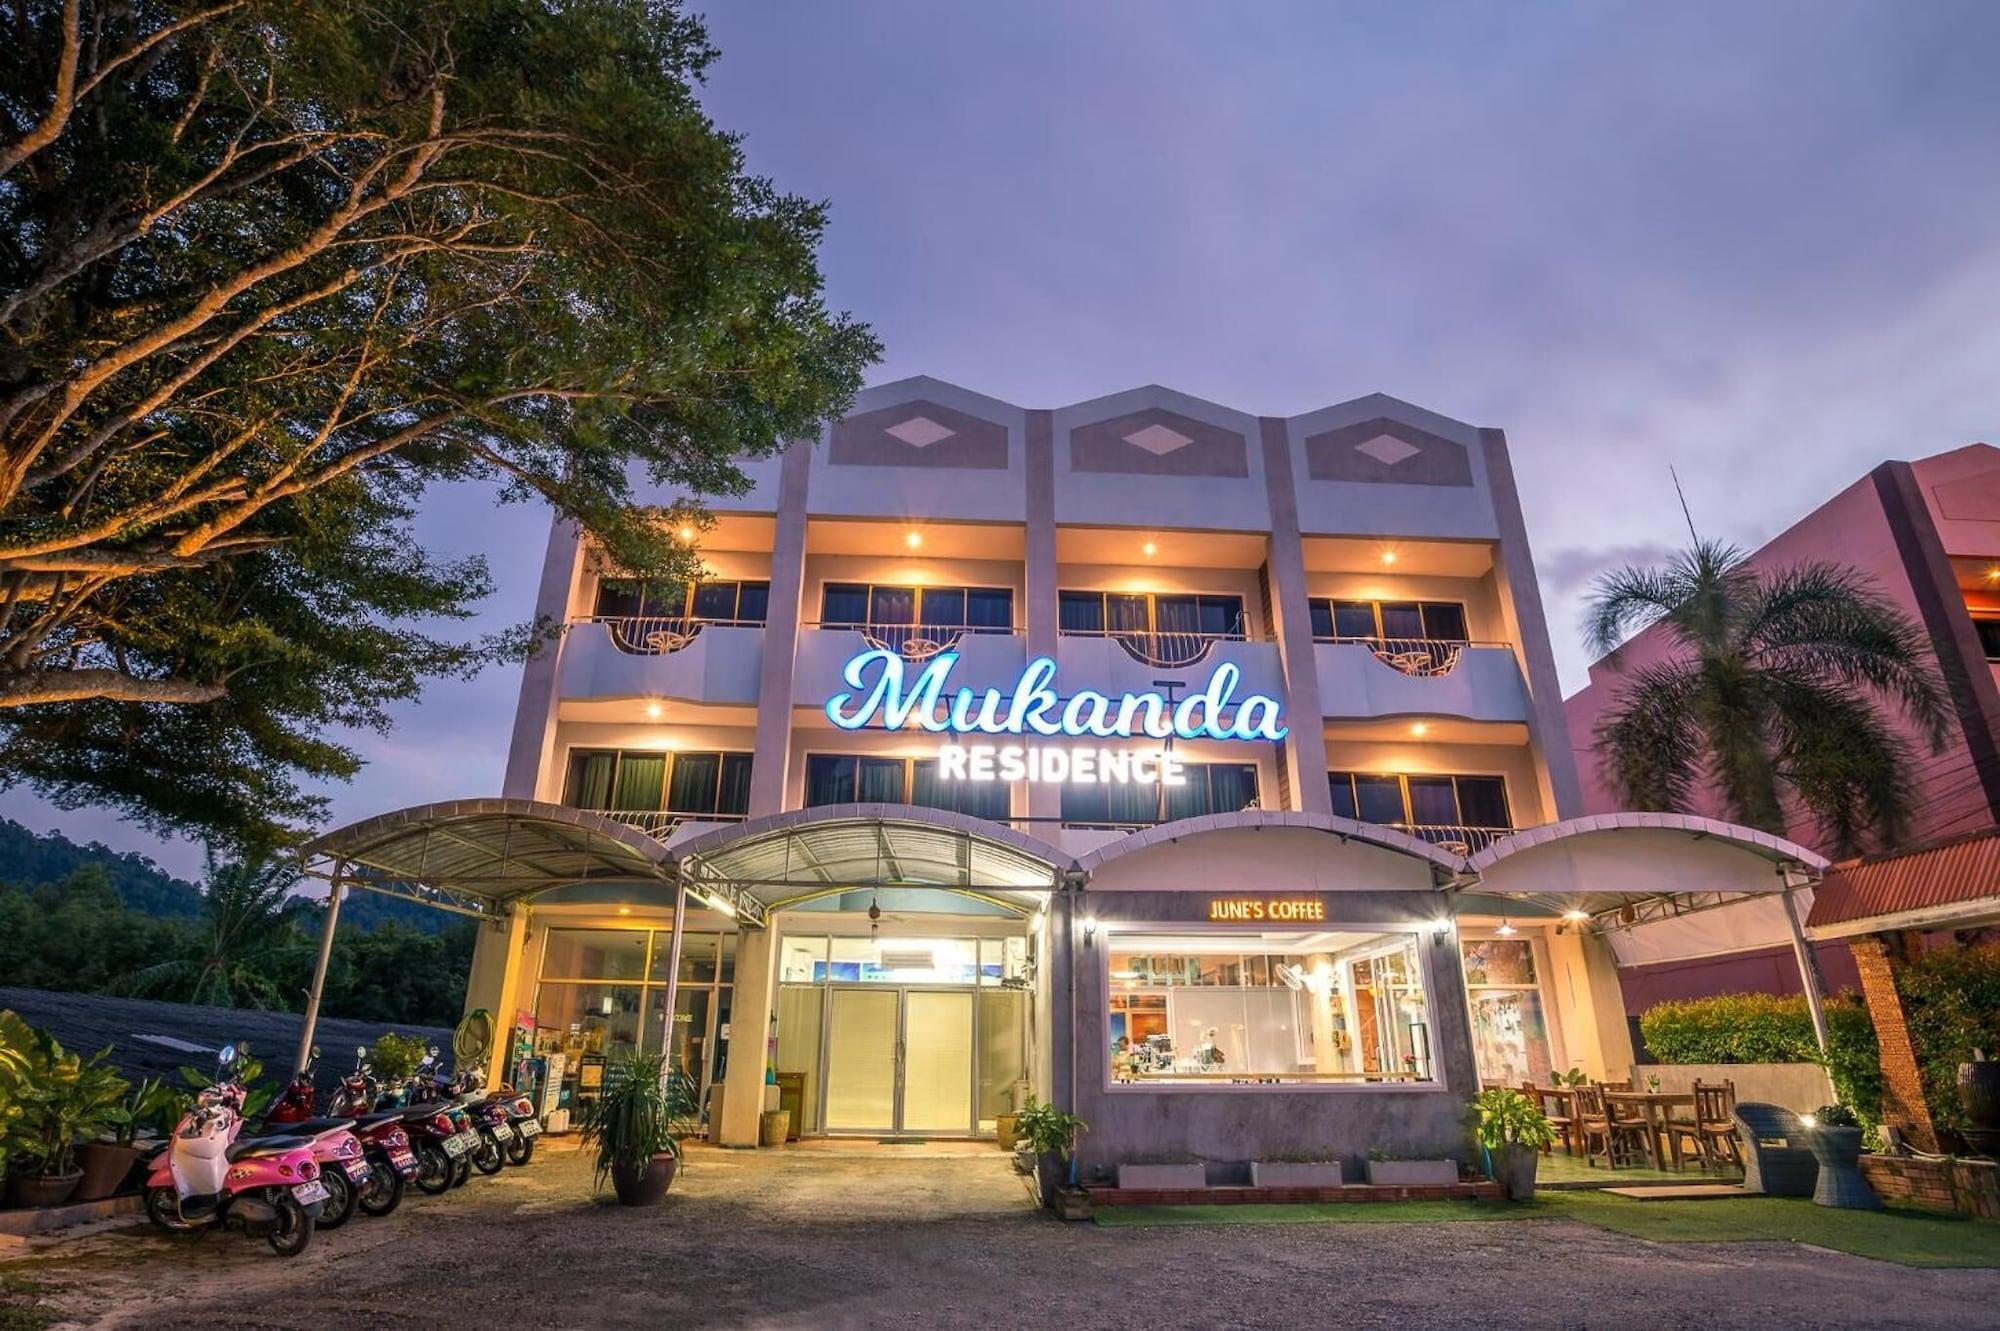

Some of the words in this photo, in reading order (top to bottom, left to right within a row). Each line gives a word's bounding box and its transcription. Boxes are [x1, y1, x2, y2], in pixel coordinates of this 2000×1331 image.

[825, 649, 1288, 740] Mukanda
[938, 745, 1187, 786] RESIDENCE
[1209, 900, 1264, 920] JUNE'S
[1268, 900, 1324, 920] COFFEE
